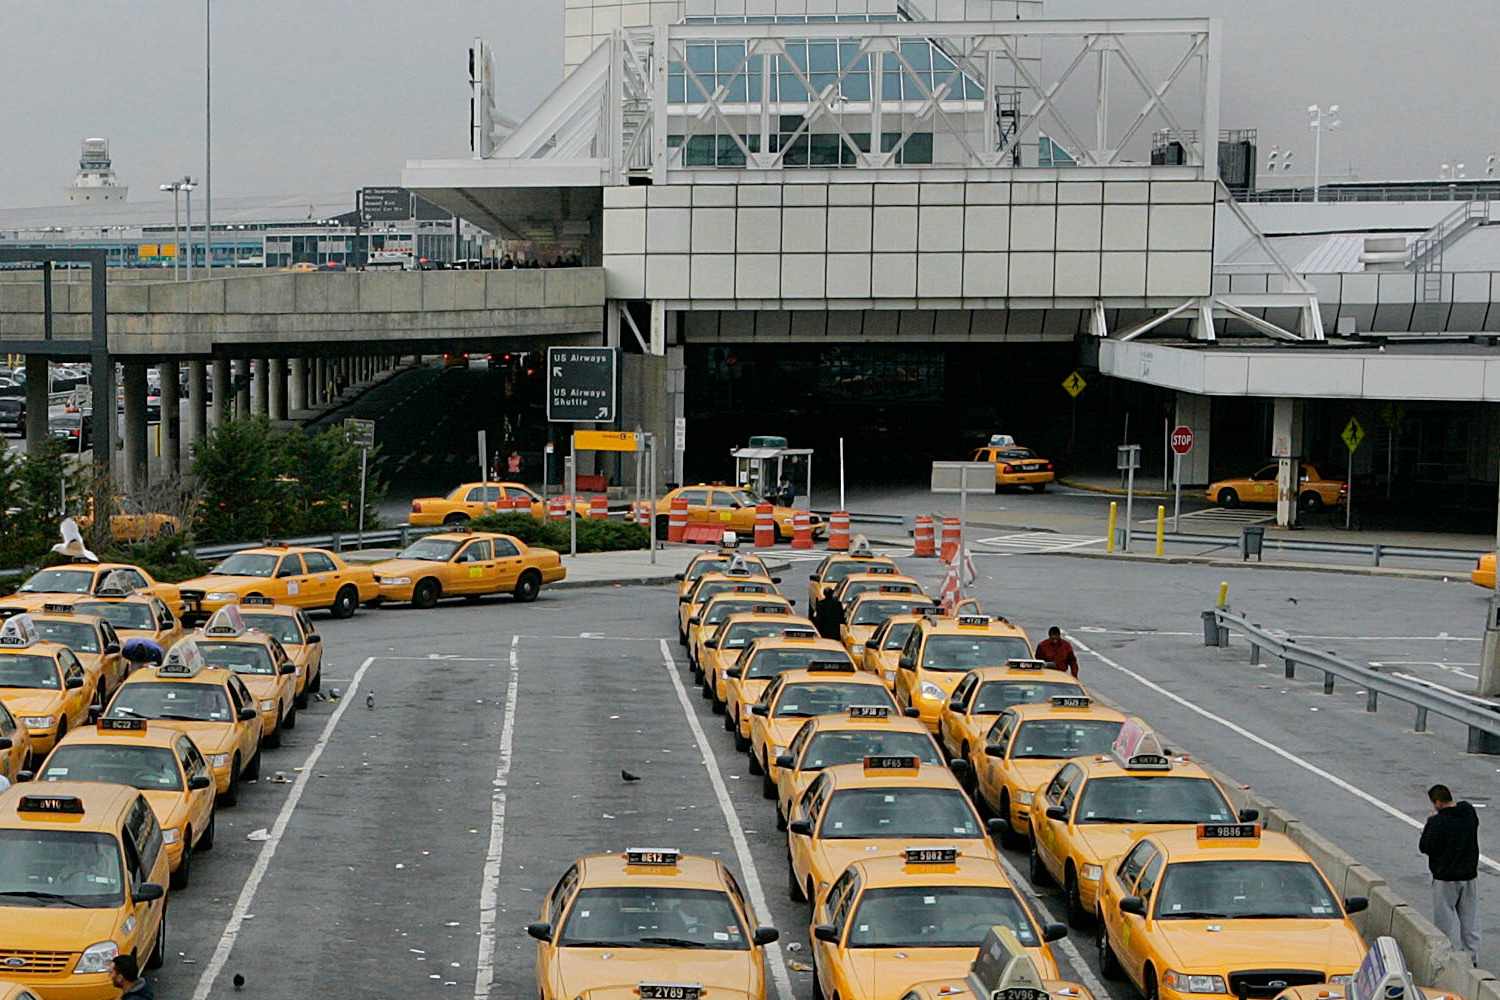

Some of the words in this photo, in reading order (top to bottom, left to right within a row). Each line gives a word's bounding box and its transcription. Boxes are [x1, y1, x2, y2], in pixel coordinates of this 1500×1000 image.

[554, 354, 566, 362] US
[571, 354, 606, 363] Airways
[554, 388, 566, 396] US
[571, 388, 606, 398] Airways
[554, 398, 588, 406] Shuttle
[1173, 435, 1191, 446] STOP
[882, 759, 901, 768] 6F65
[655, 988, 683, 998] 2Y89
[1008, 990, 1034, 1000] 2V96
